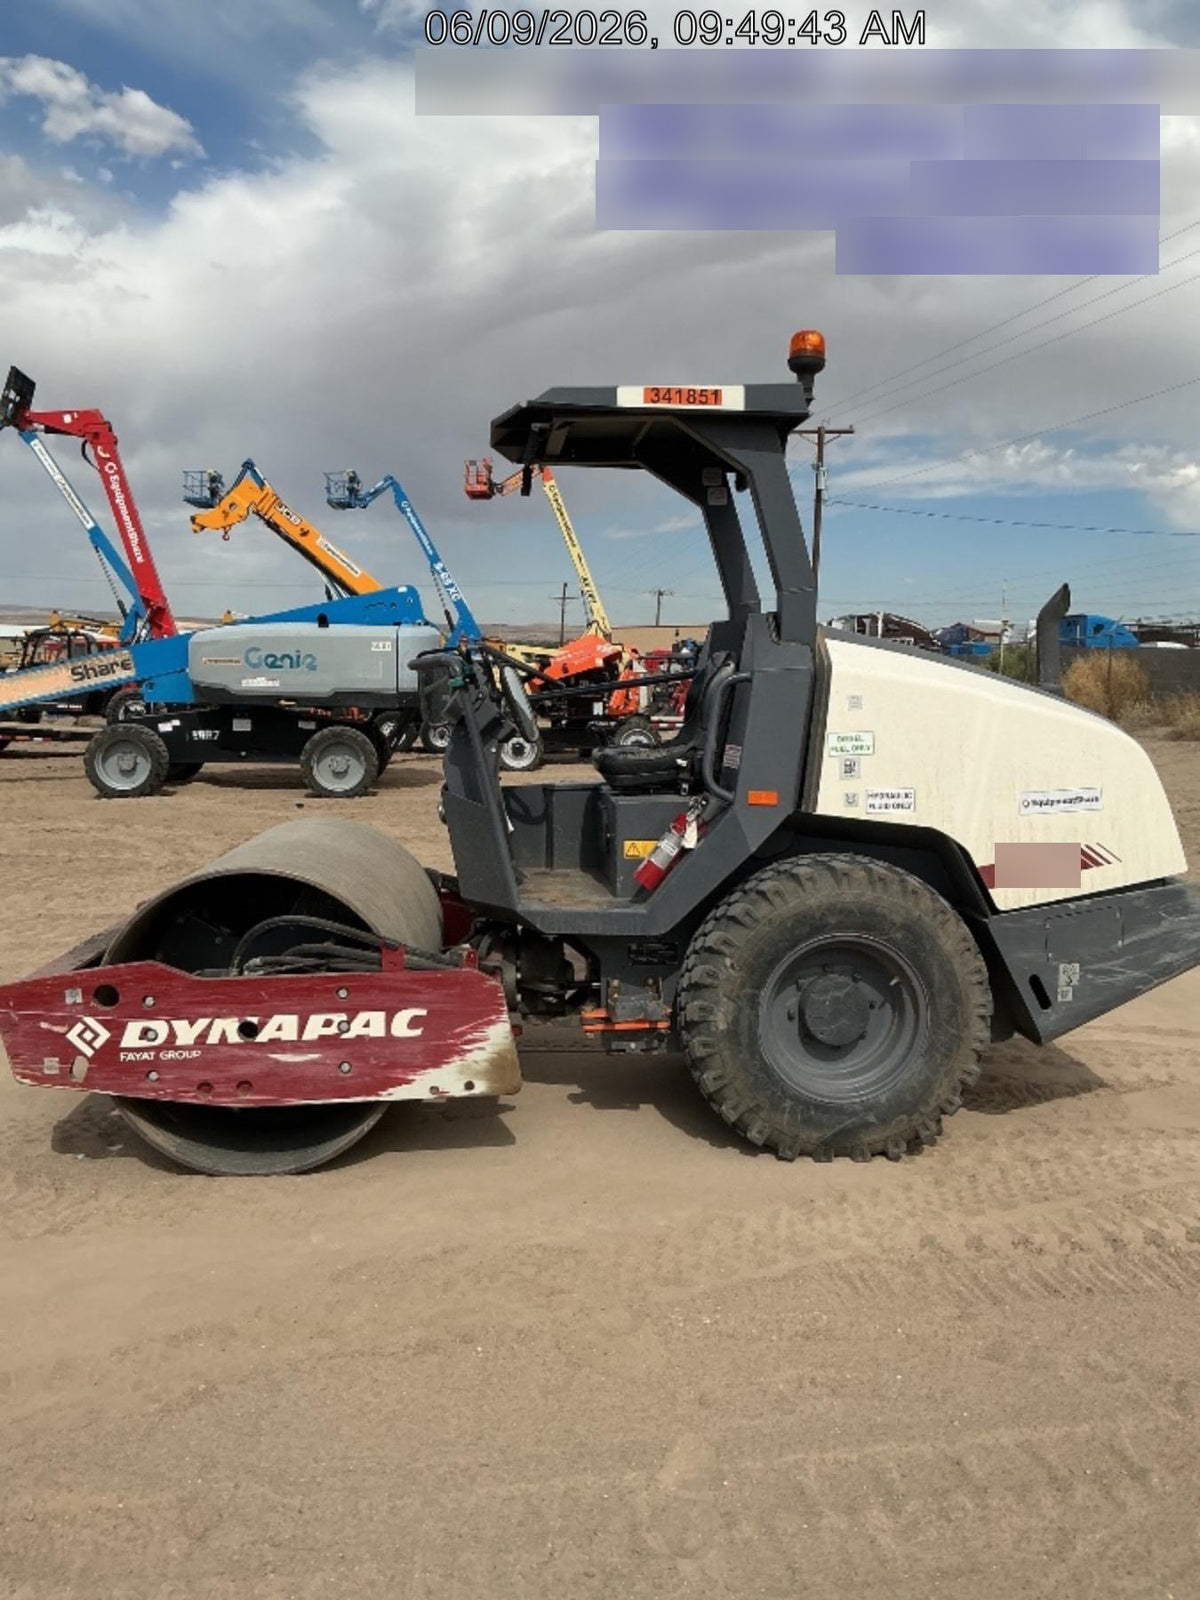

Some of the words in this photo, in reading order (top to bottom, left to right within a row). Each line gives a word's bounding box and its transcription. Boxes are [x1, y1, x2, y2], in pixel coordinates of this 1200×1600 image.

[650, 387, 719, 405] 341851
[71, 658, 132, 682] Share
[245, 647, 318, 671] Genie
[120, 1008, 428, 1049] DYNAPAC
[120, 1051, 155, 1062] FAYAT
[160, 1050, 202, 1061] GROUP
